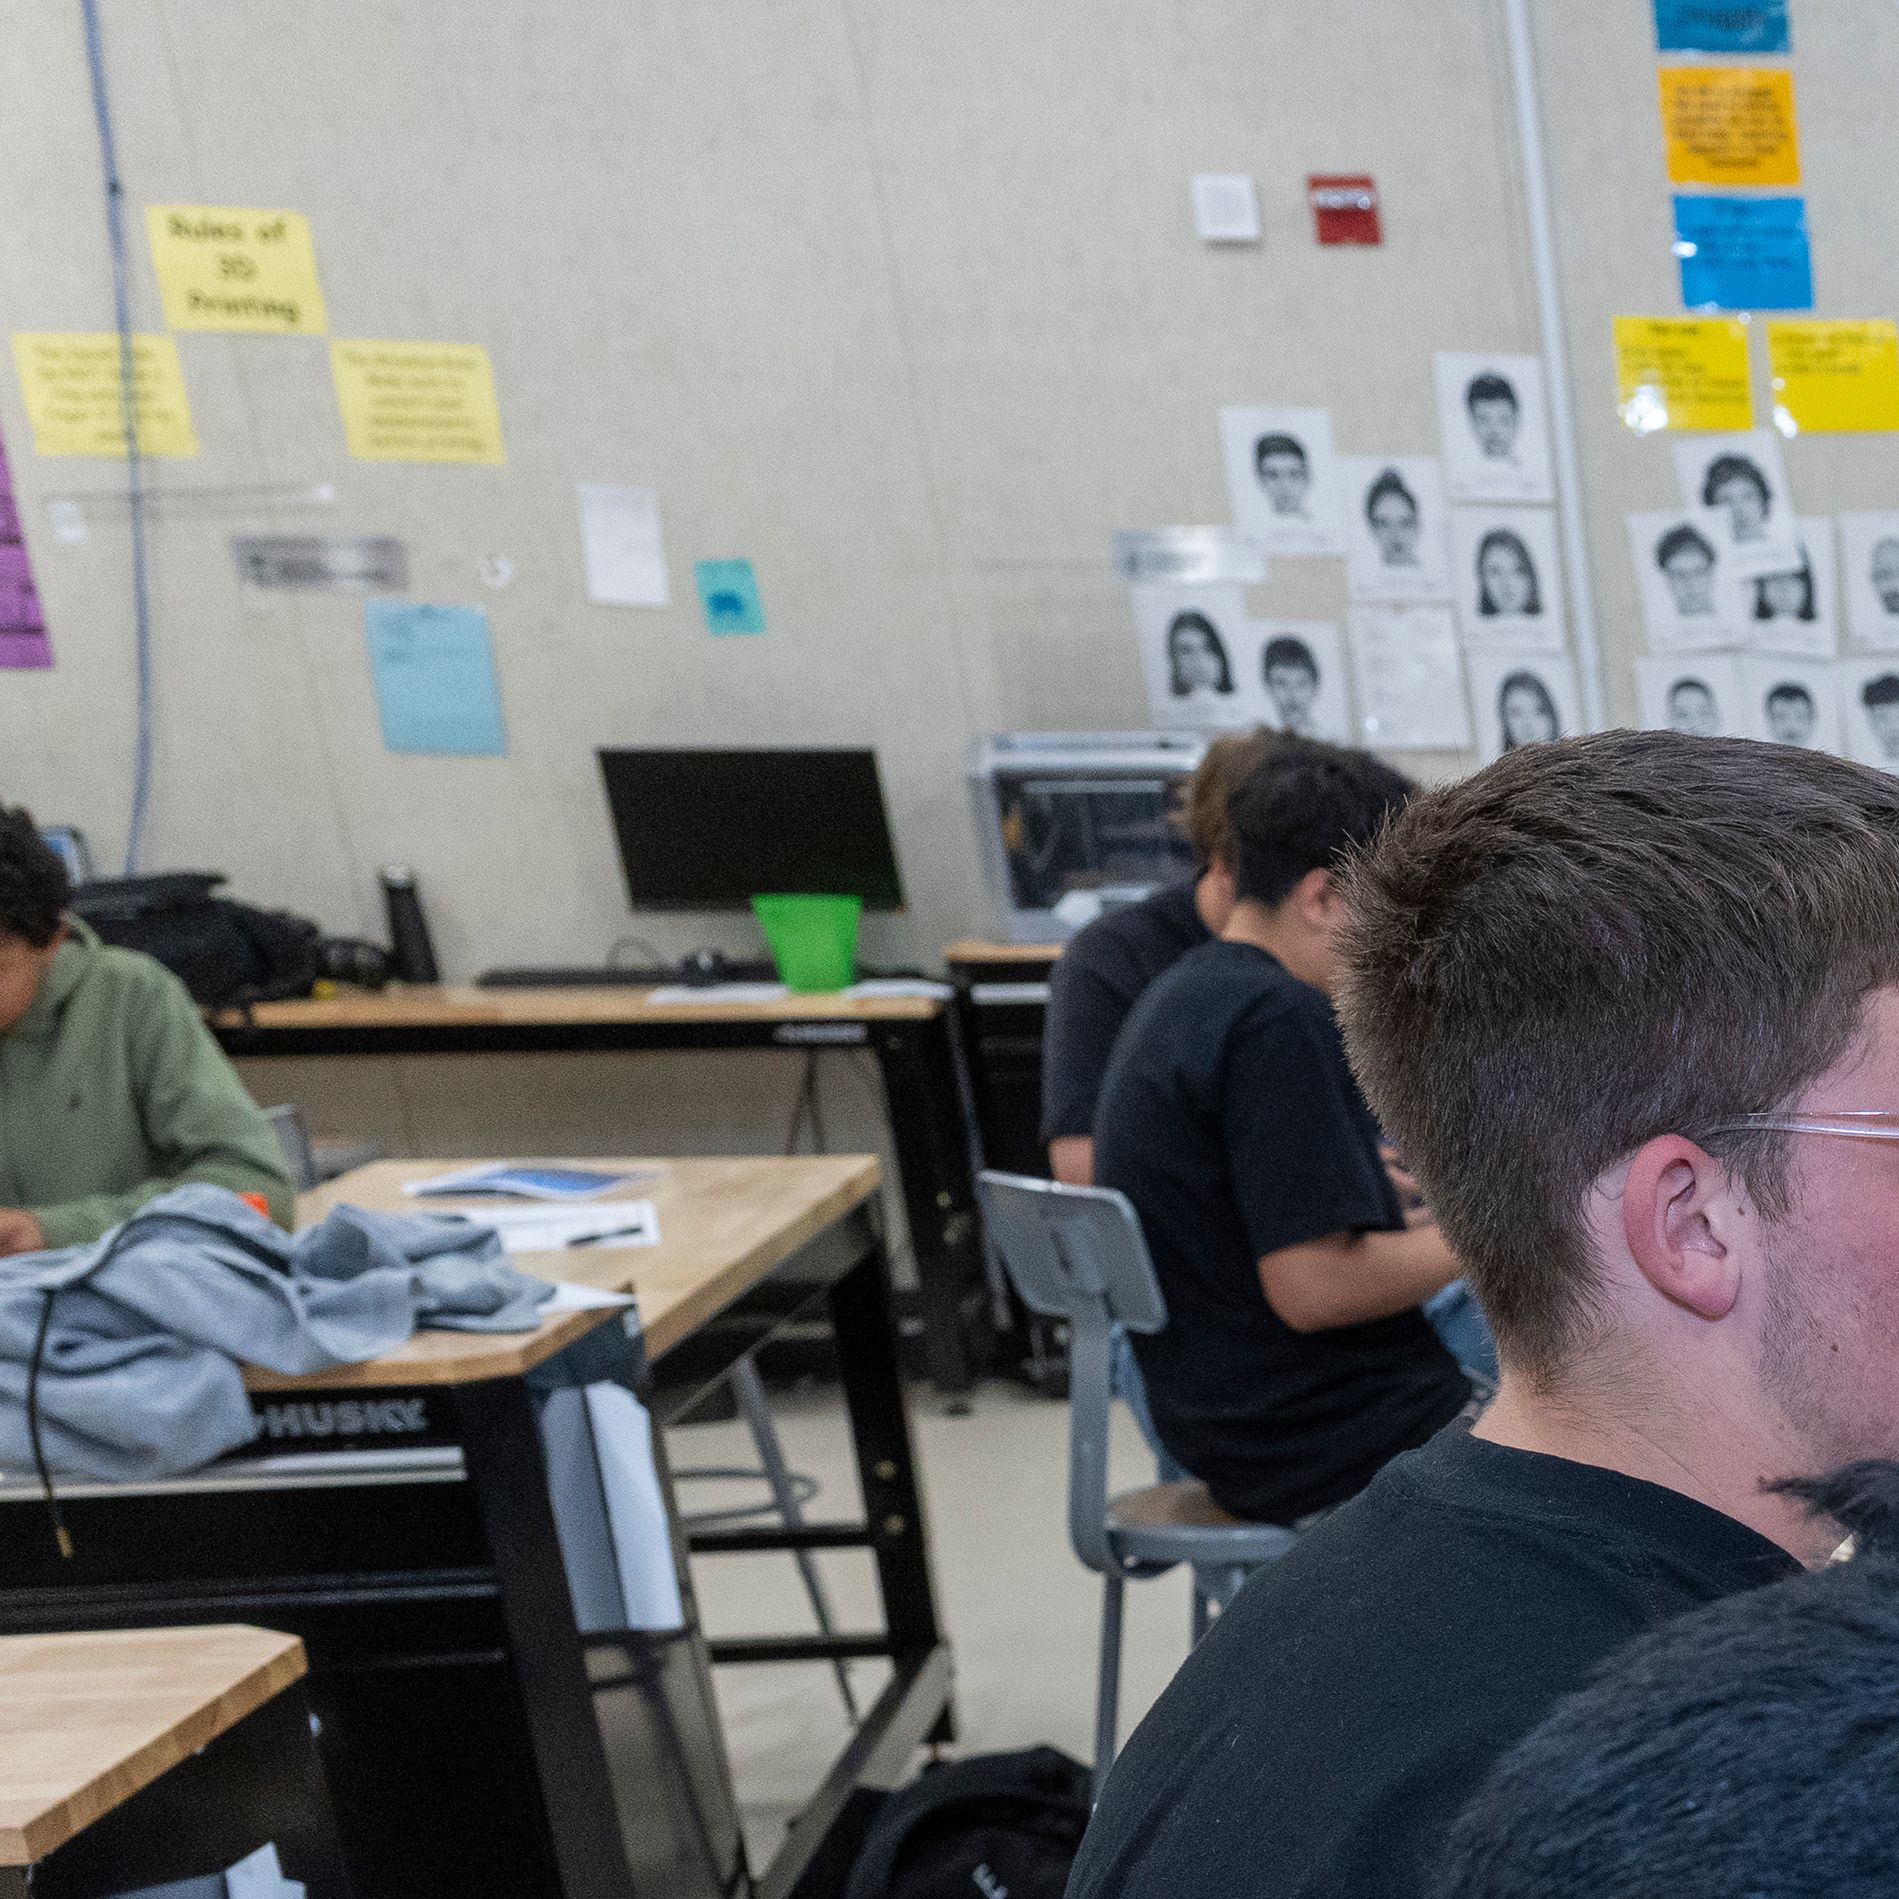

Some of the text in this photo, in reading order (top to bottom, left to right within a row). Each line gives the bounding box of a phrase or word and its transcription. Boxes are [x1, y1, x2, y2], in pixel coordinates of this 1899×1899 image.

[168, 215, 286, 243] Rules of
[188, 290, 299, 324] Printing
[263, 1398, 428, 1438] HUSKY
